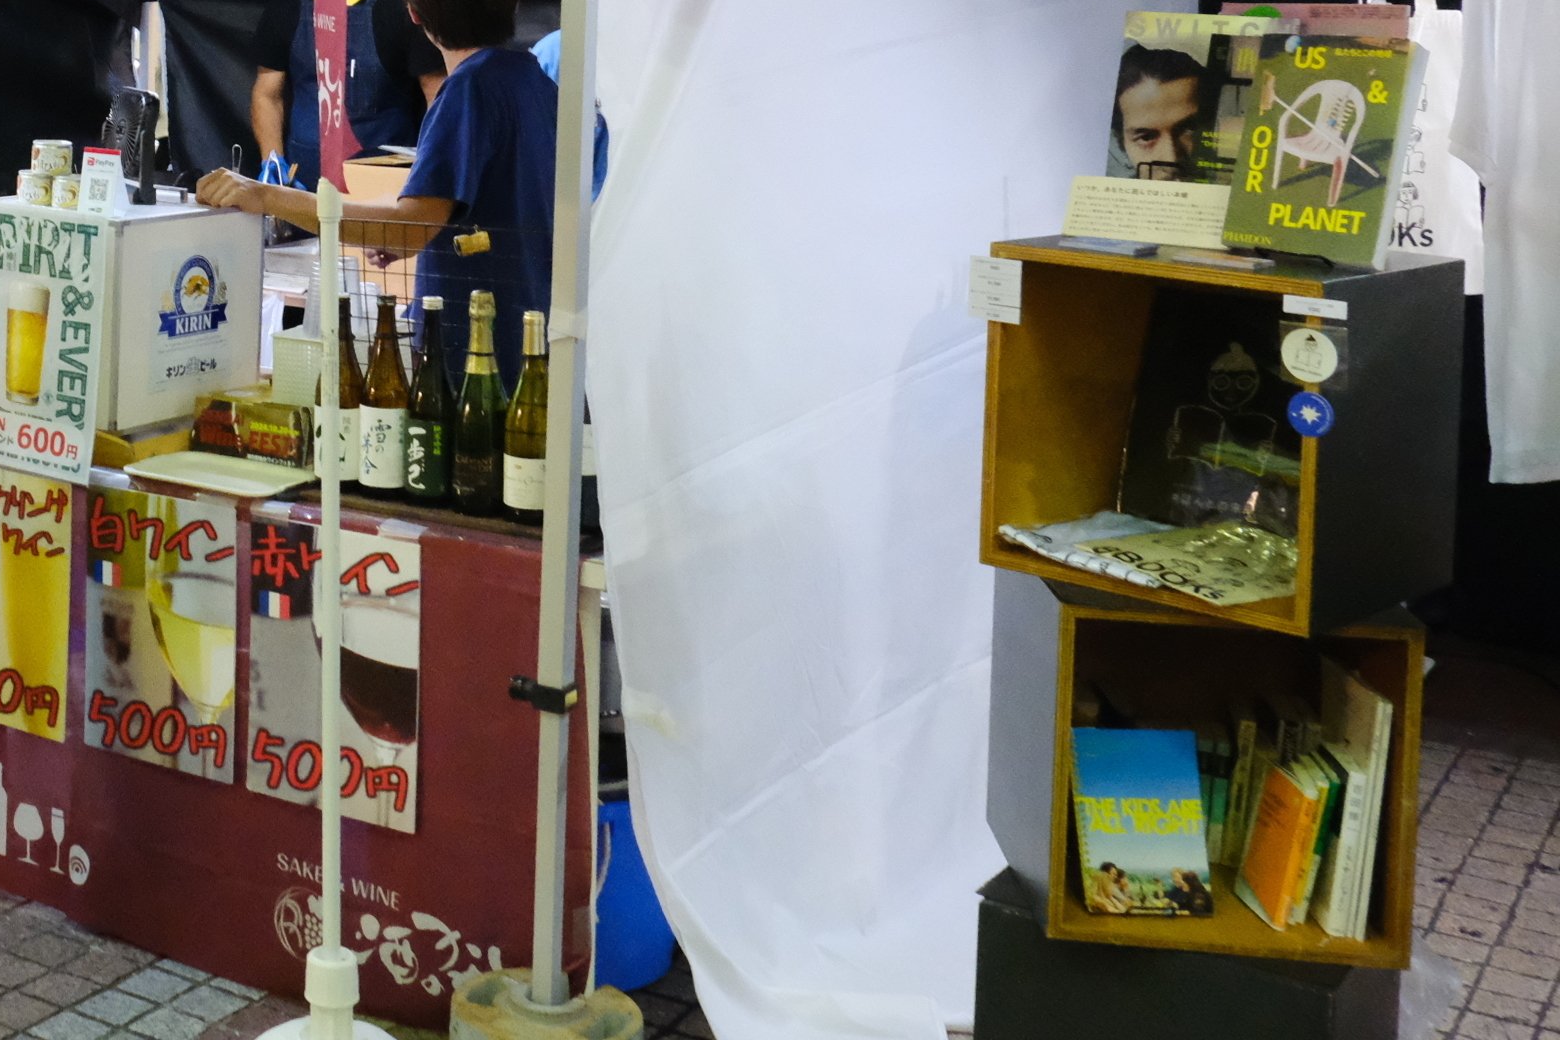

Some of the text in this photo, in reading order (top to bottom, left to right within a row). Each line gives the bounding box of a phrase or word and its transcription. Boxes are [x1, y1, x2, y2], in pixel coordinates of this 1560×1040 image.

[1294, 46, 1328, 70] US
[1367, 79, 1389, 105] &
[1245, 125, 1274, 194] OUR
[1268, 202, 1367, 236] PLANET
[1223, 230, 1273, 246] PHAIDON
[60, 284, 95, 317] &
[175, 312, 213, 336] KIRIN
[17, 423, 78, 460] 600円
[2, 522, 65, 558] ワイン
[89, 495, 235, 563] 白ワイン
[88, 690, 228, 768] 500円
[276, 852, 401, 911] SAKE WINE
